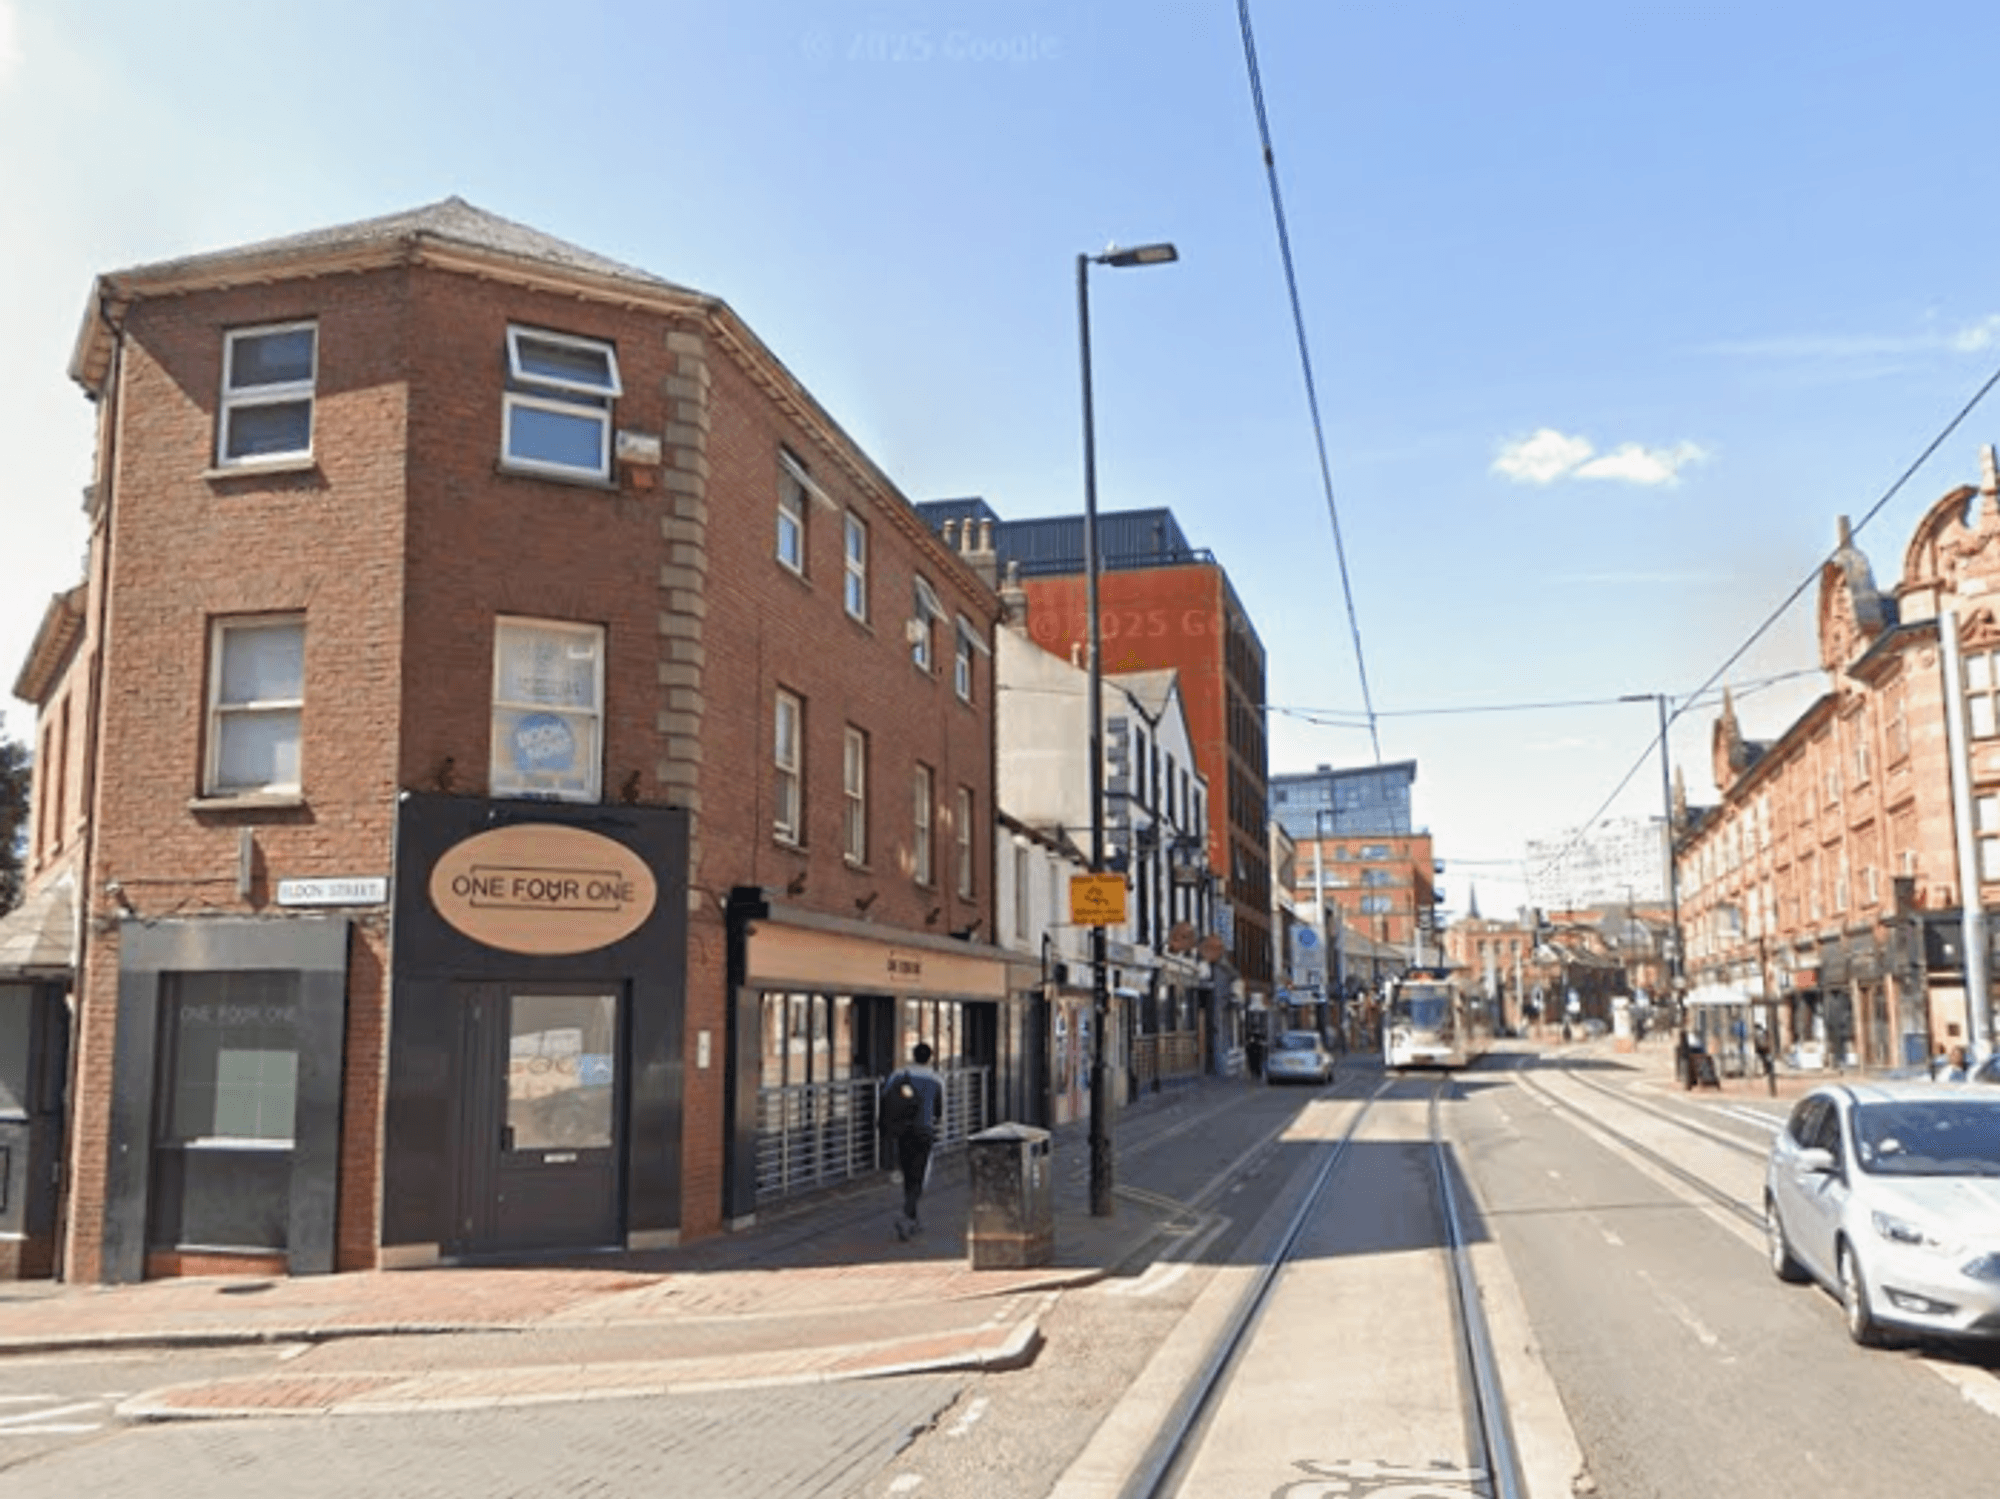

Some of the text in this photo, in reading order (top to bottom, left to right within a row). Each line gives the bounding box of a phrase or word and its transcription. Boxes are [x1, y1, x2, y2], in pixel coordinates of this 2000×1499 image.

[452, 875, 635, 903] ONE FOUR ONE
[181, 1005, 213, 1022] ONE
[265, 1005, 297, 1024] ONE
